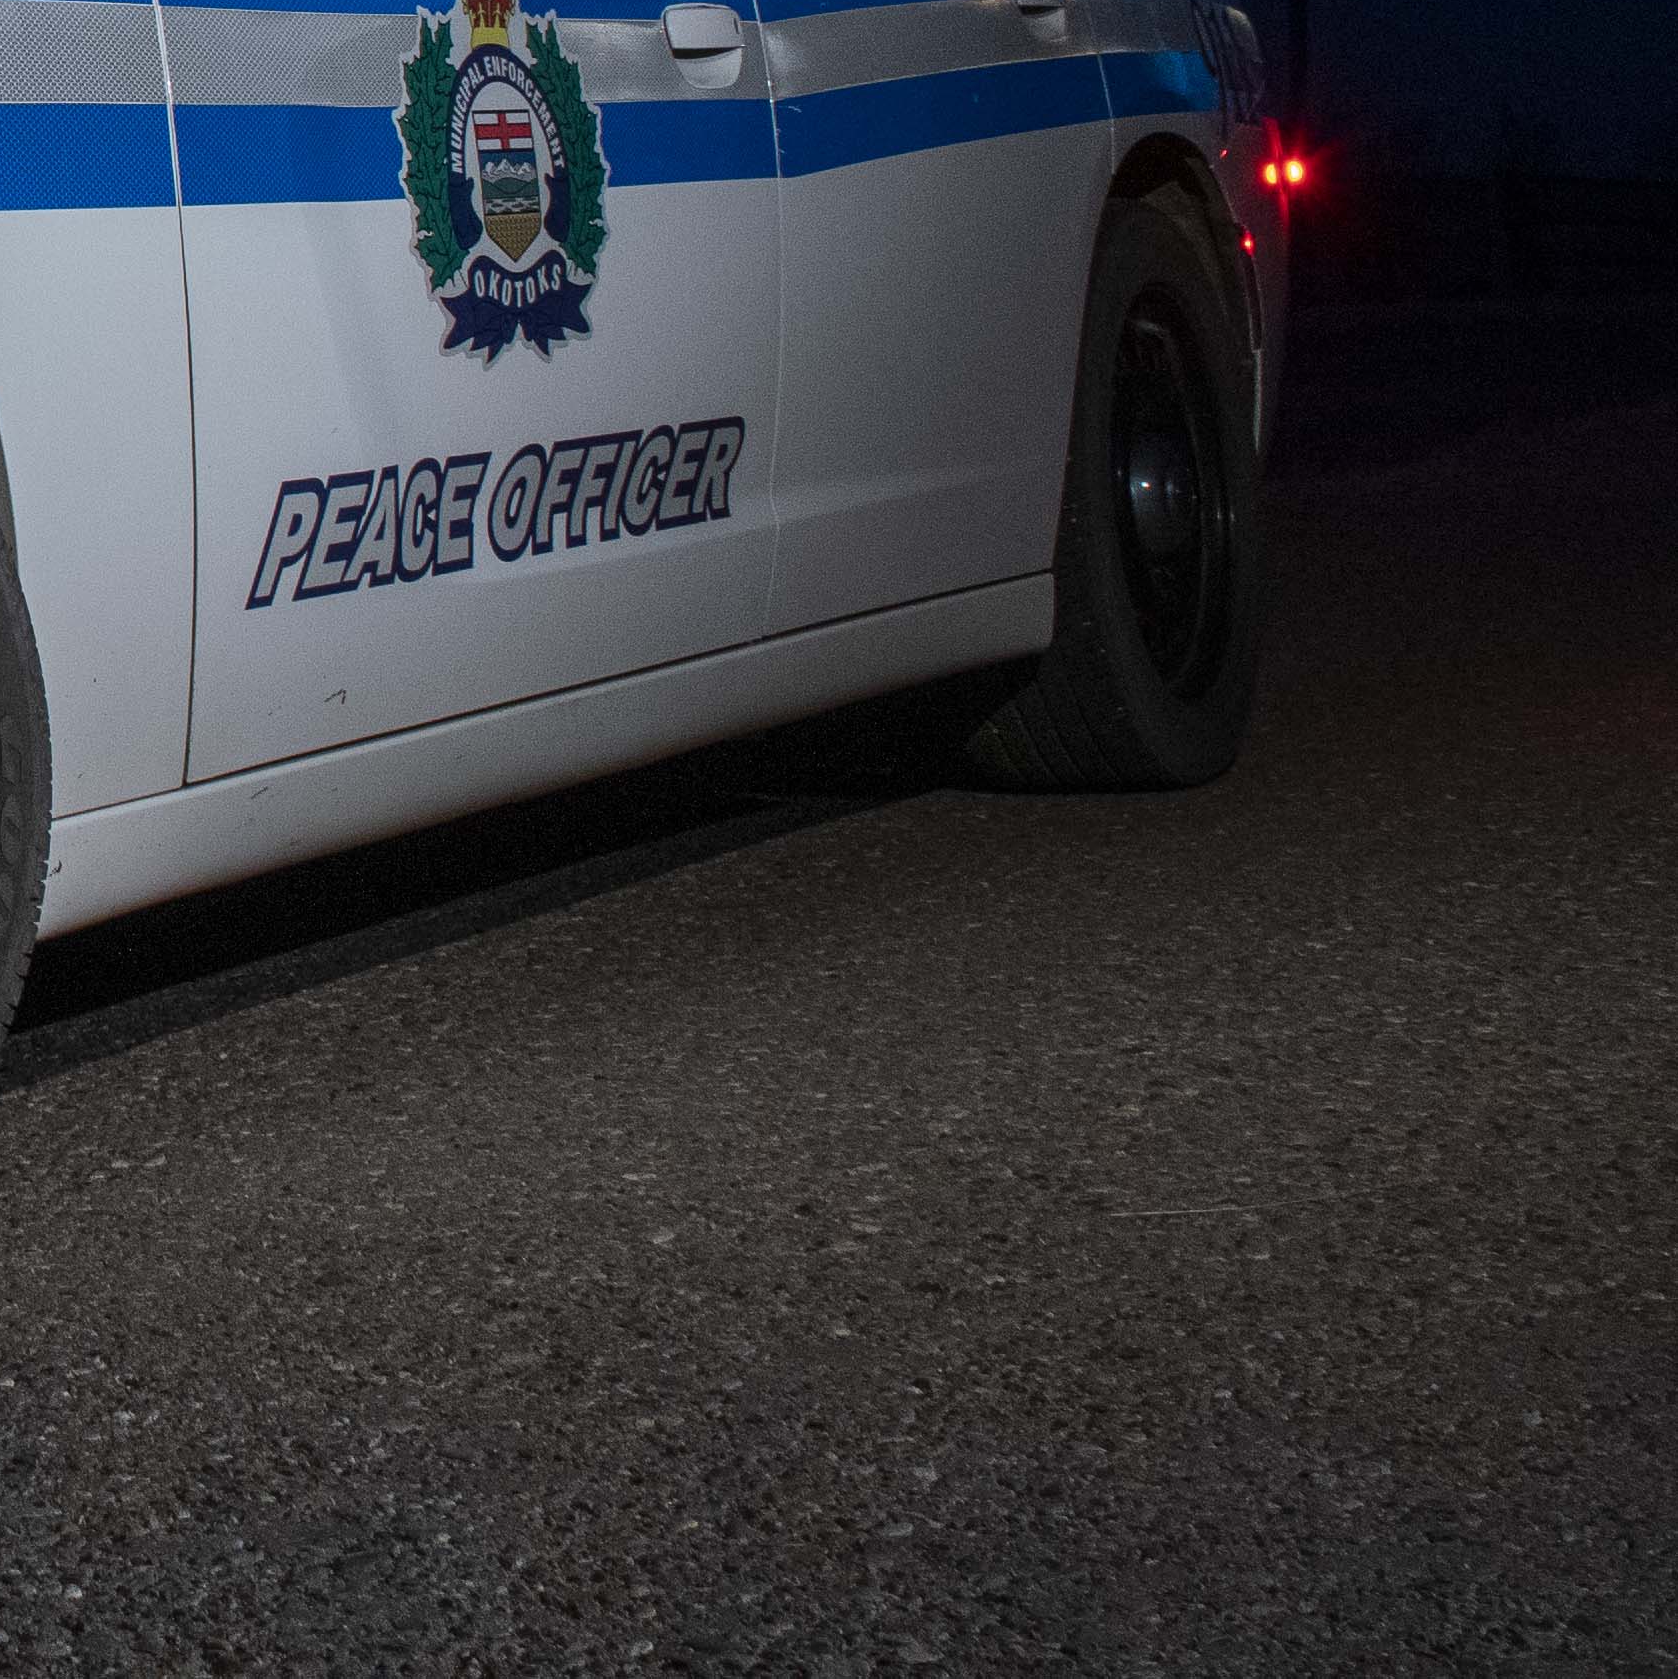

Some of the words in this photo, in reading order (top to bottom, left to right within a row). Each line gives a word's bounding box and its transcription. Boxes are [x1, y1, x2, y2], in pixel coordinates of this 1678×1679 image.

[450, 62, 485, 174] MUNICIPAL
[482, 55, 566, 169] ENFORCEMENT
[474, 264, 561, 308] OKOTOKS
[244, 451, 492, 612] PEACE
[487, 415, 745, 562] OFFICER
